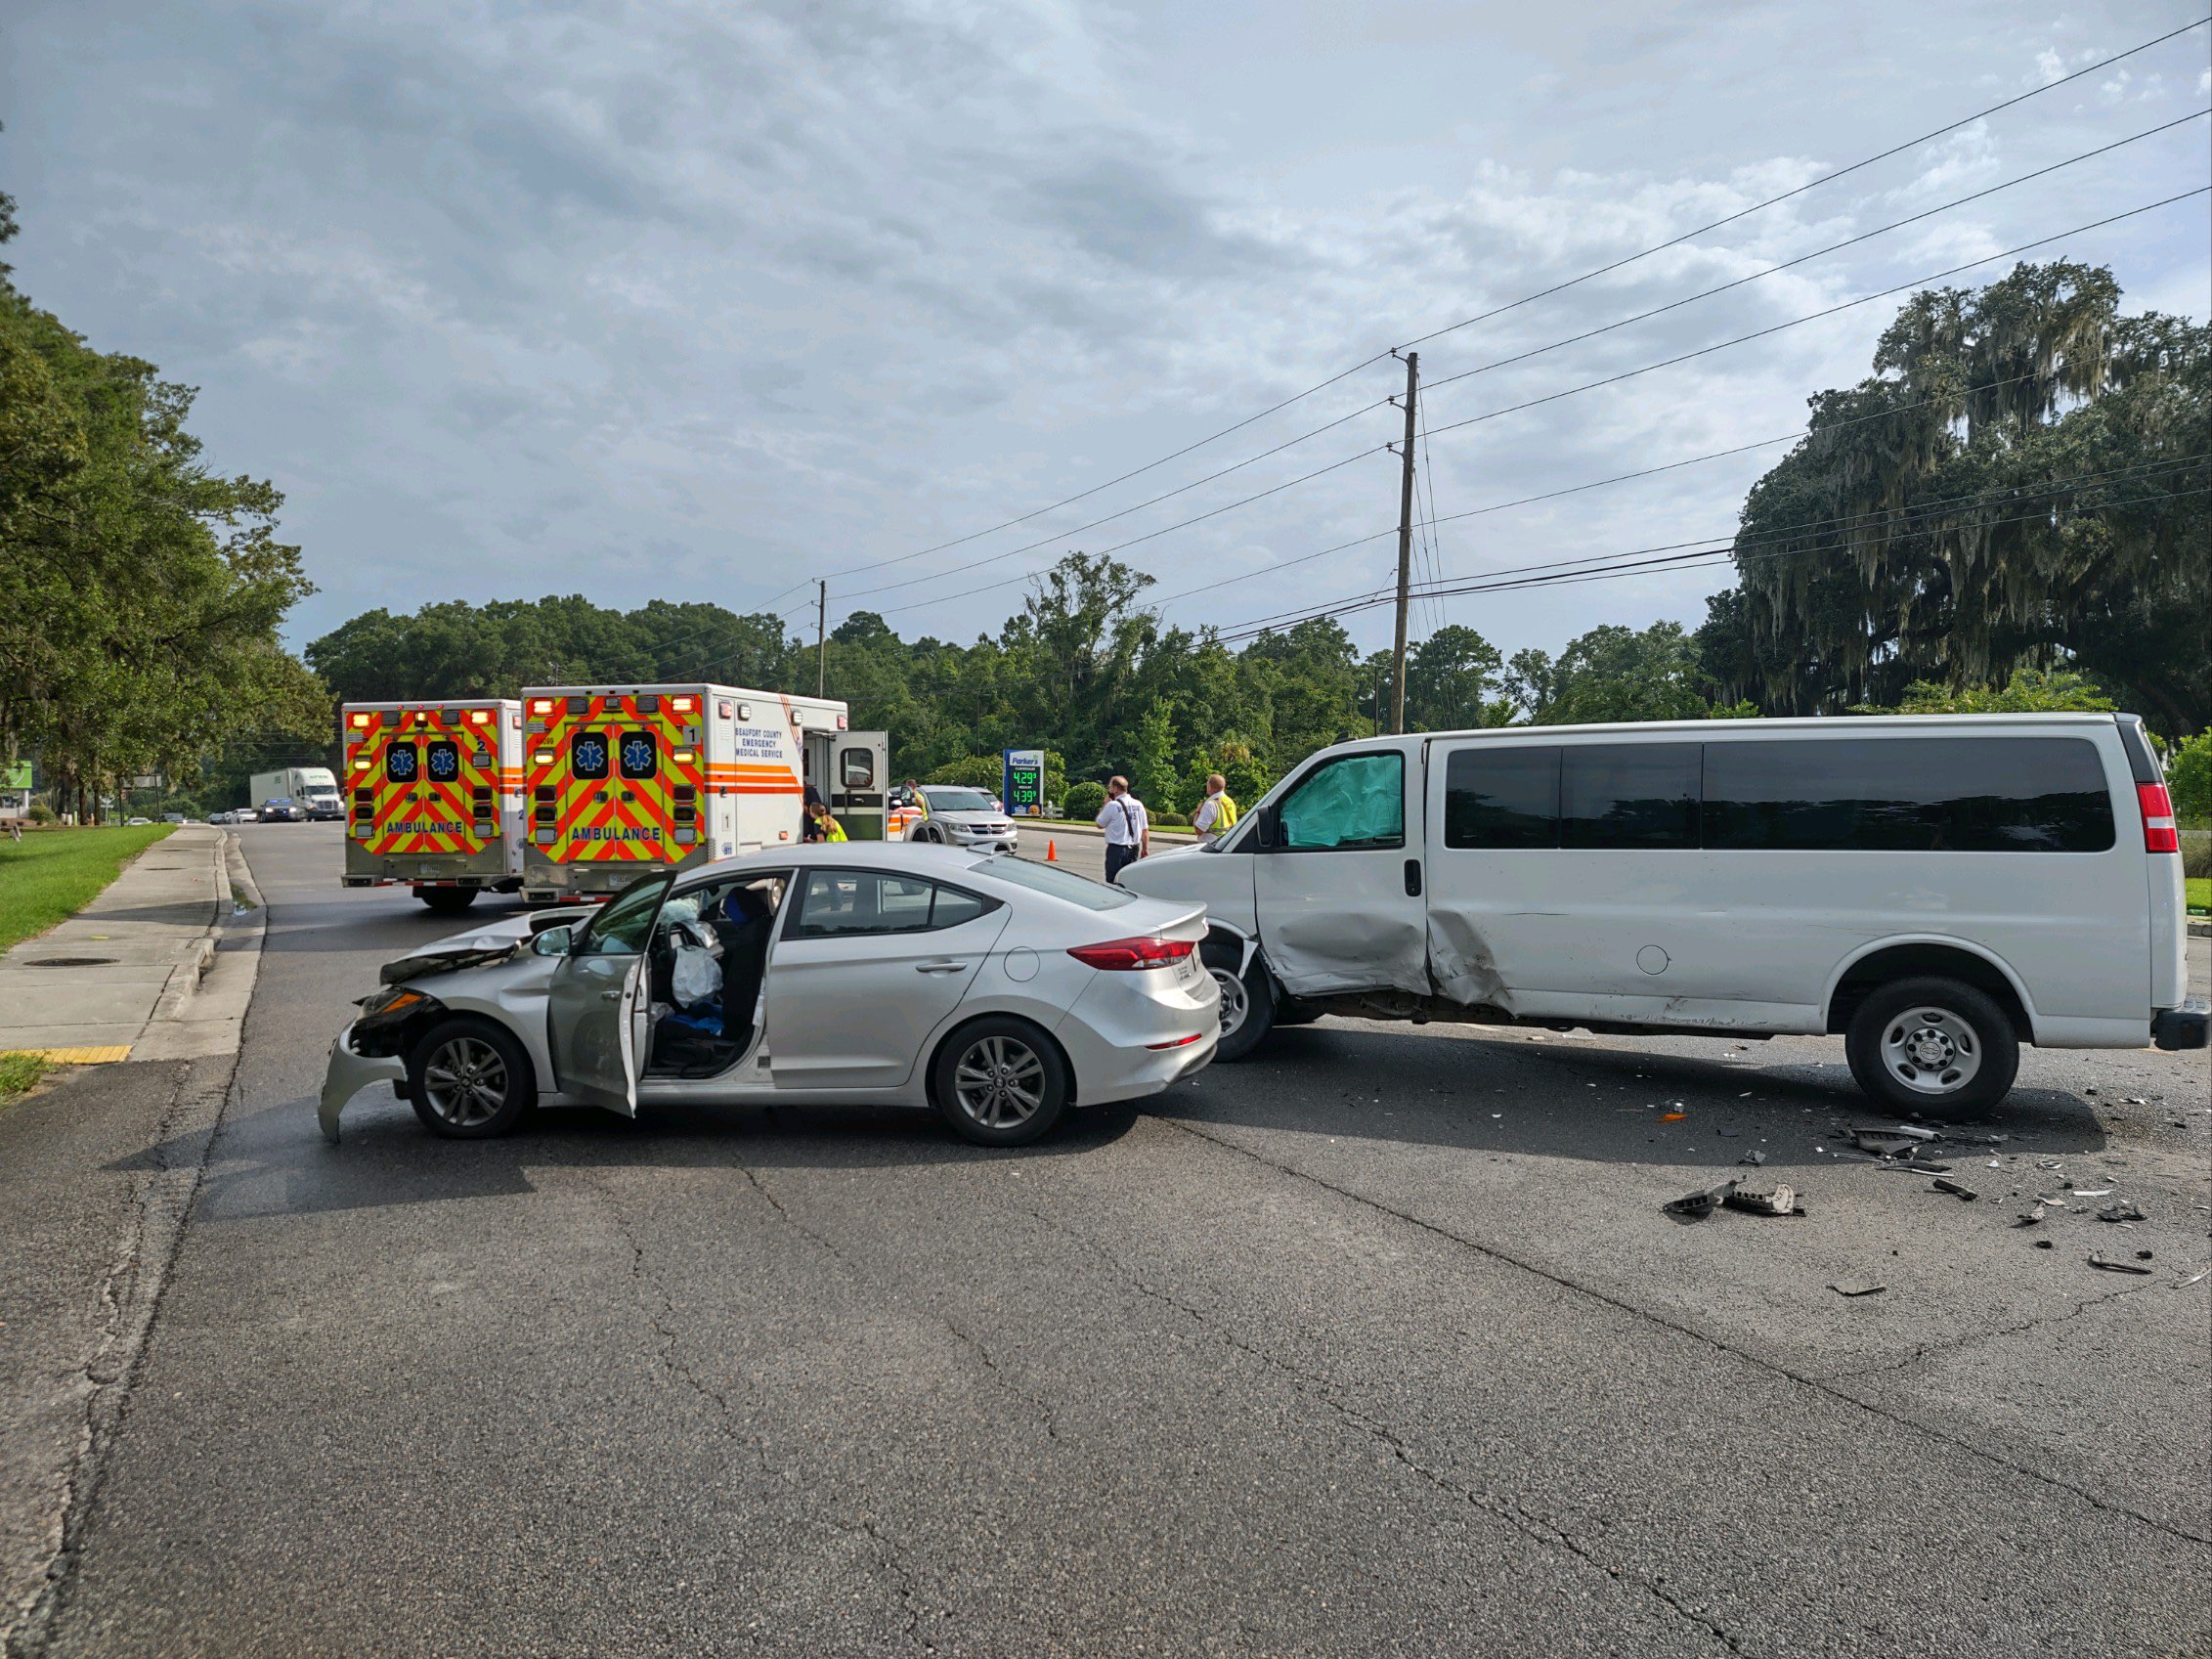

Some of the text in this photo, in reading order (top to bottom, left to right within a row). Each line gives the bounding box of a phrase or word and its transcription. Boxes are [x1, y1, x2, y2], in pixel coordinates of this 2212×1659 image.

[688, 728, 696, 742] 1
[735, 727, 782, 739] BEAUFORT COUNTY
[477, 740, 486, 752] 2
[742, 738, 776, 748] EMERGENCY
[735, 747, 783, 759] MEDICAL SERVICE
[386, 821, 462, 834] AMBULANCE
[572, 827, 661, 841] AMBULANCE
